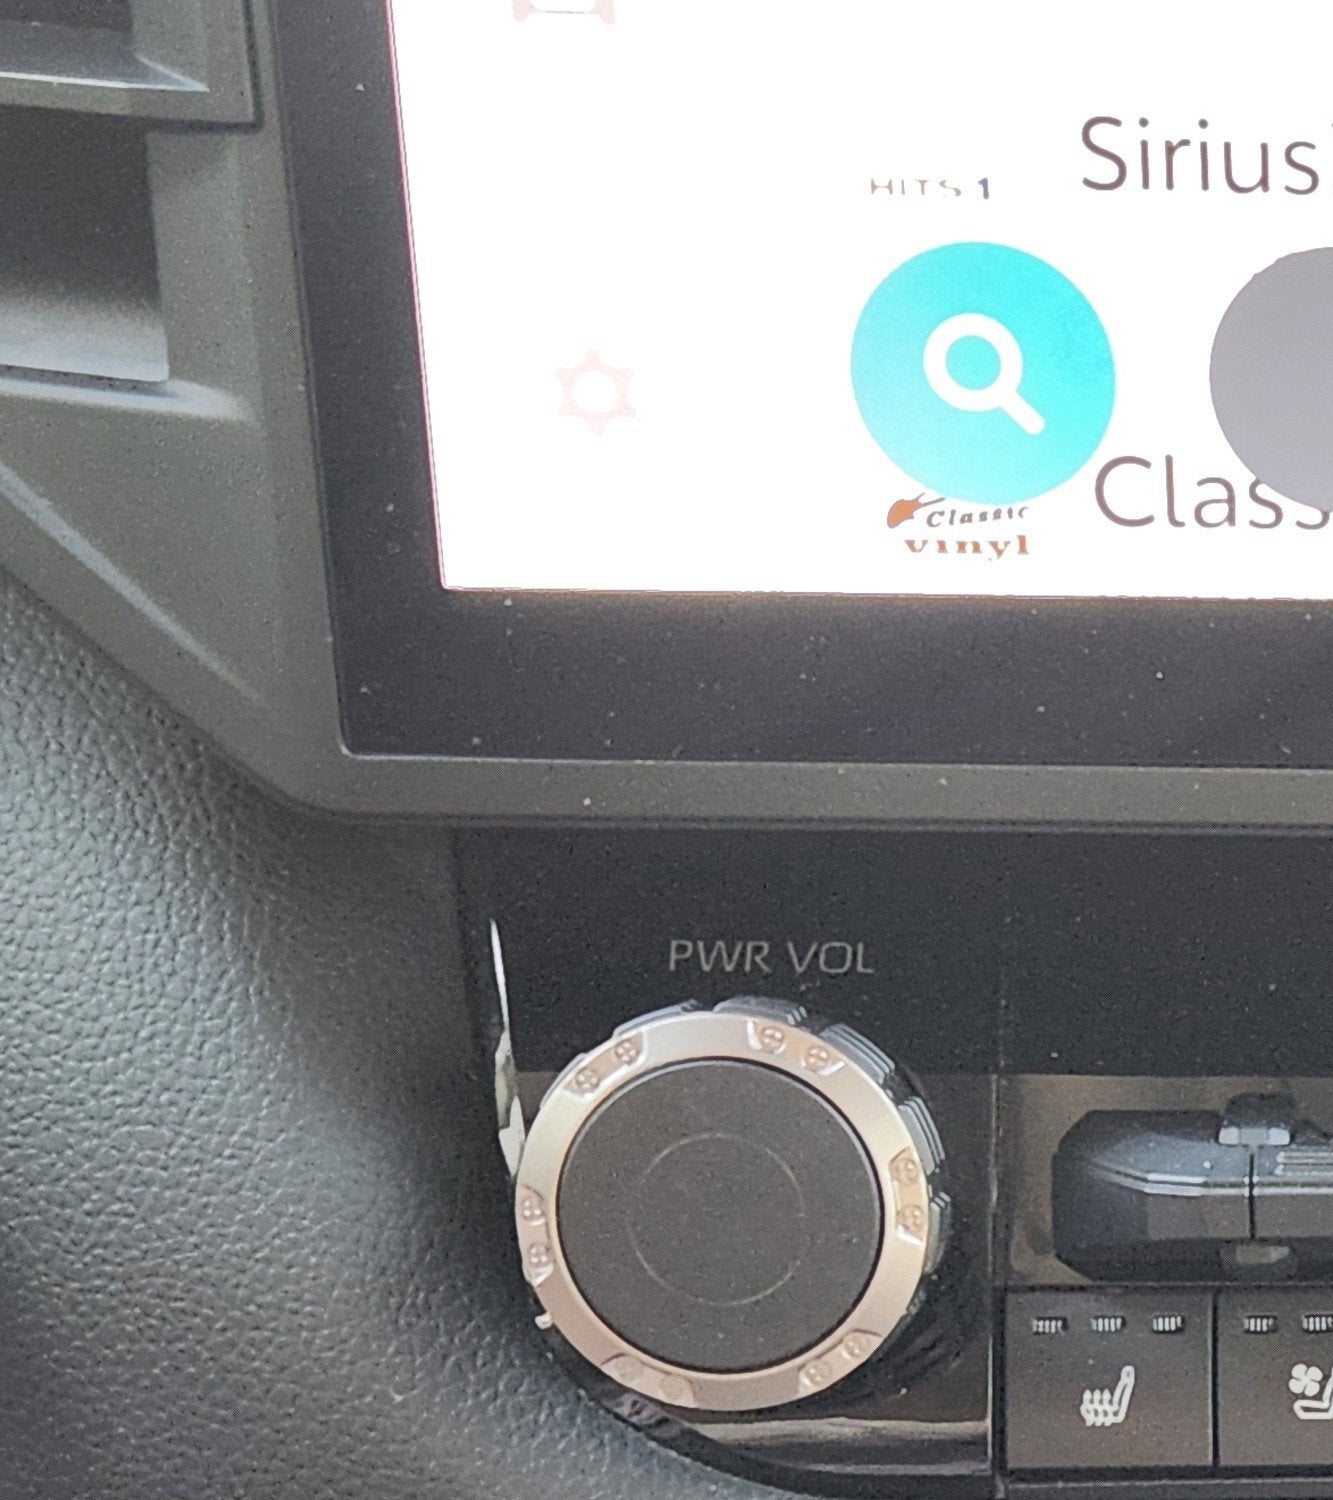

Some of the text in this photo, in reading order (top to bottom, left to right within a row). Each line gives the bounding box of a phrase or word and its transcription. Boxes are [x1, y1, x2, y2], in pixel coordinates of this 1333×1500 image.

[870, 177, 990, 200] HITS 1
[904, 535, 1029, 561] vinyl
[668, 940, 875, 974] PWR VOL
